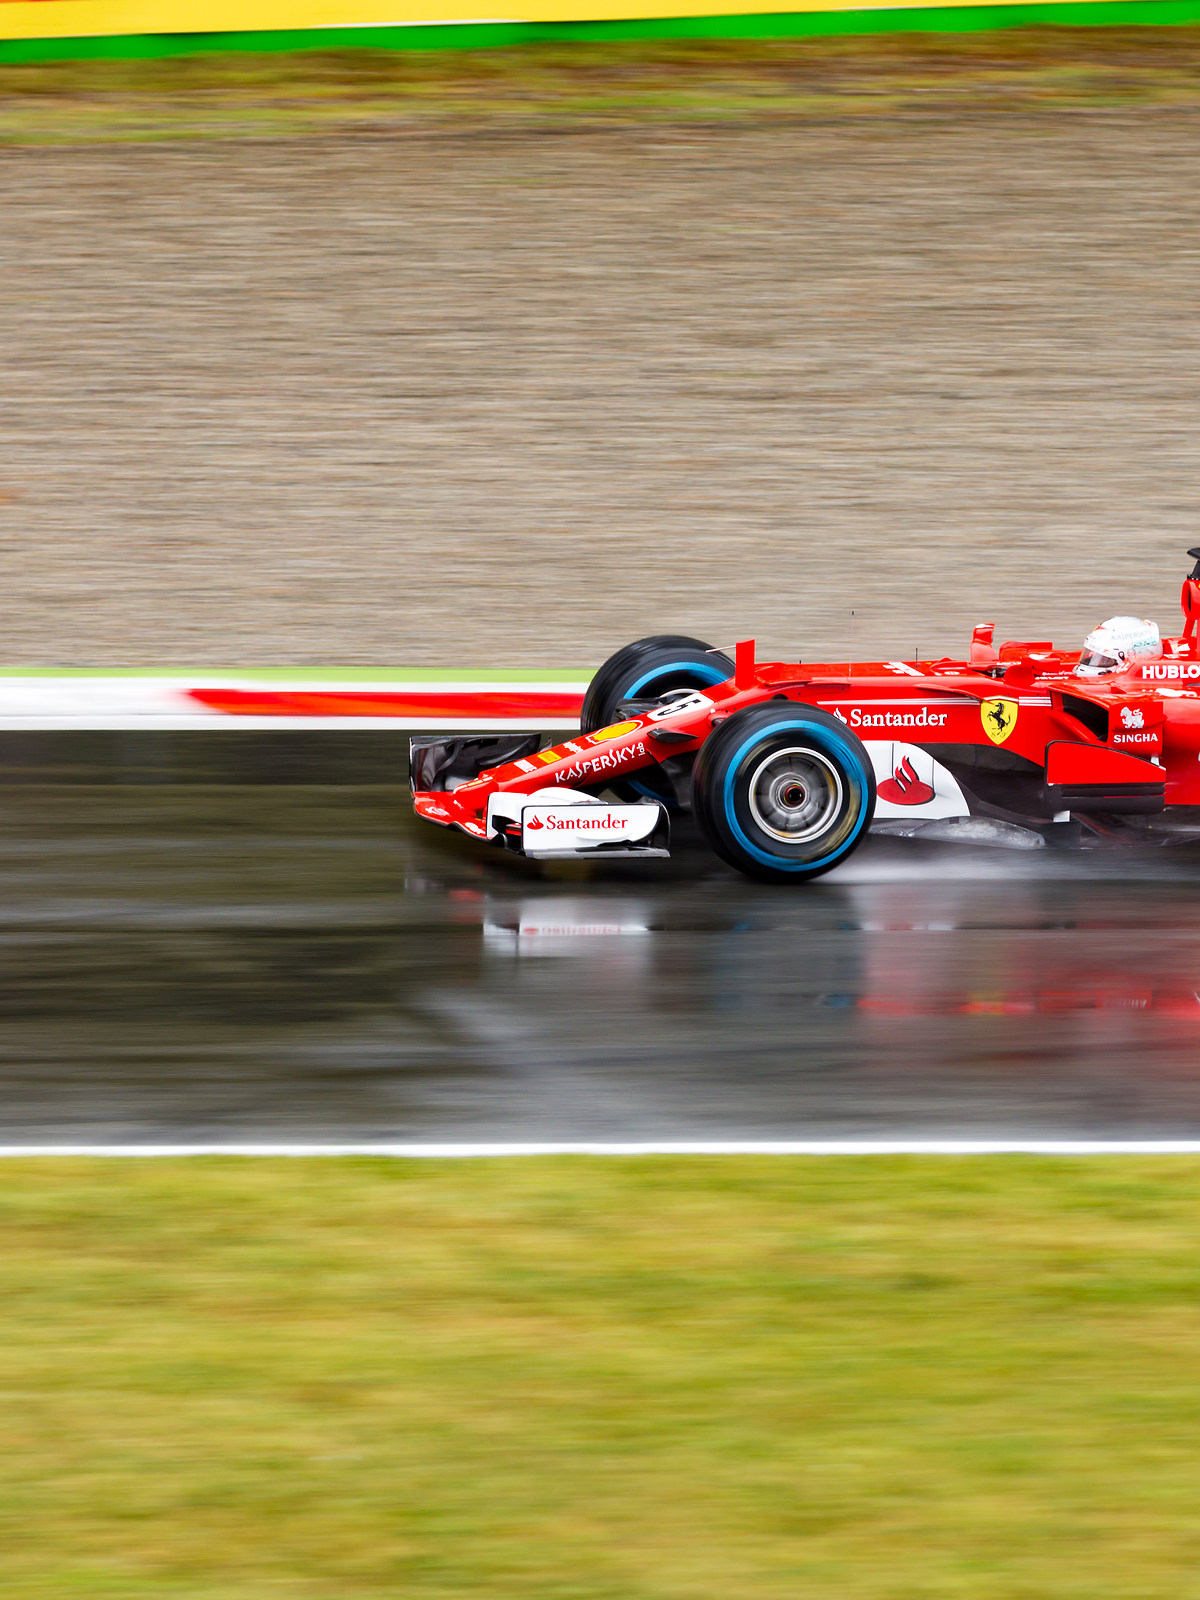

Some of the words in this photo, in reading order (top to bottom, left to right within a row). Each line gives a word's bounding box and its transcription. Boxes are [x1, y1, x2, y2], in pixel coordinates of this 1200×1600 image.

[850, 707, 948, 727] Santander
[1113, 733, 1159, 744] SINGHA
[555, 743, 636, 783] KASPERSKY
[546, 813, 628, 830] Santander
